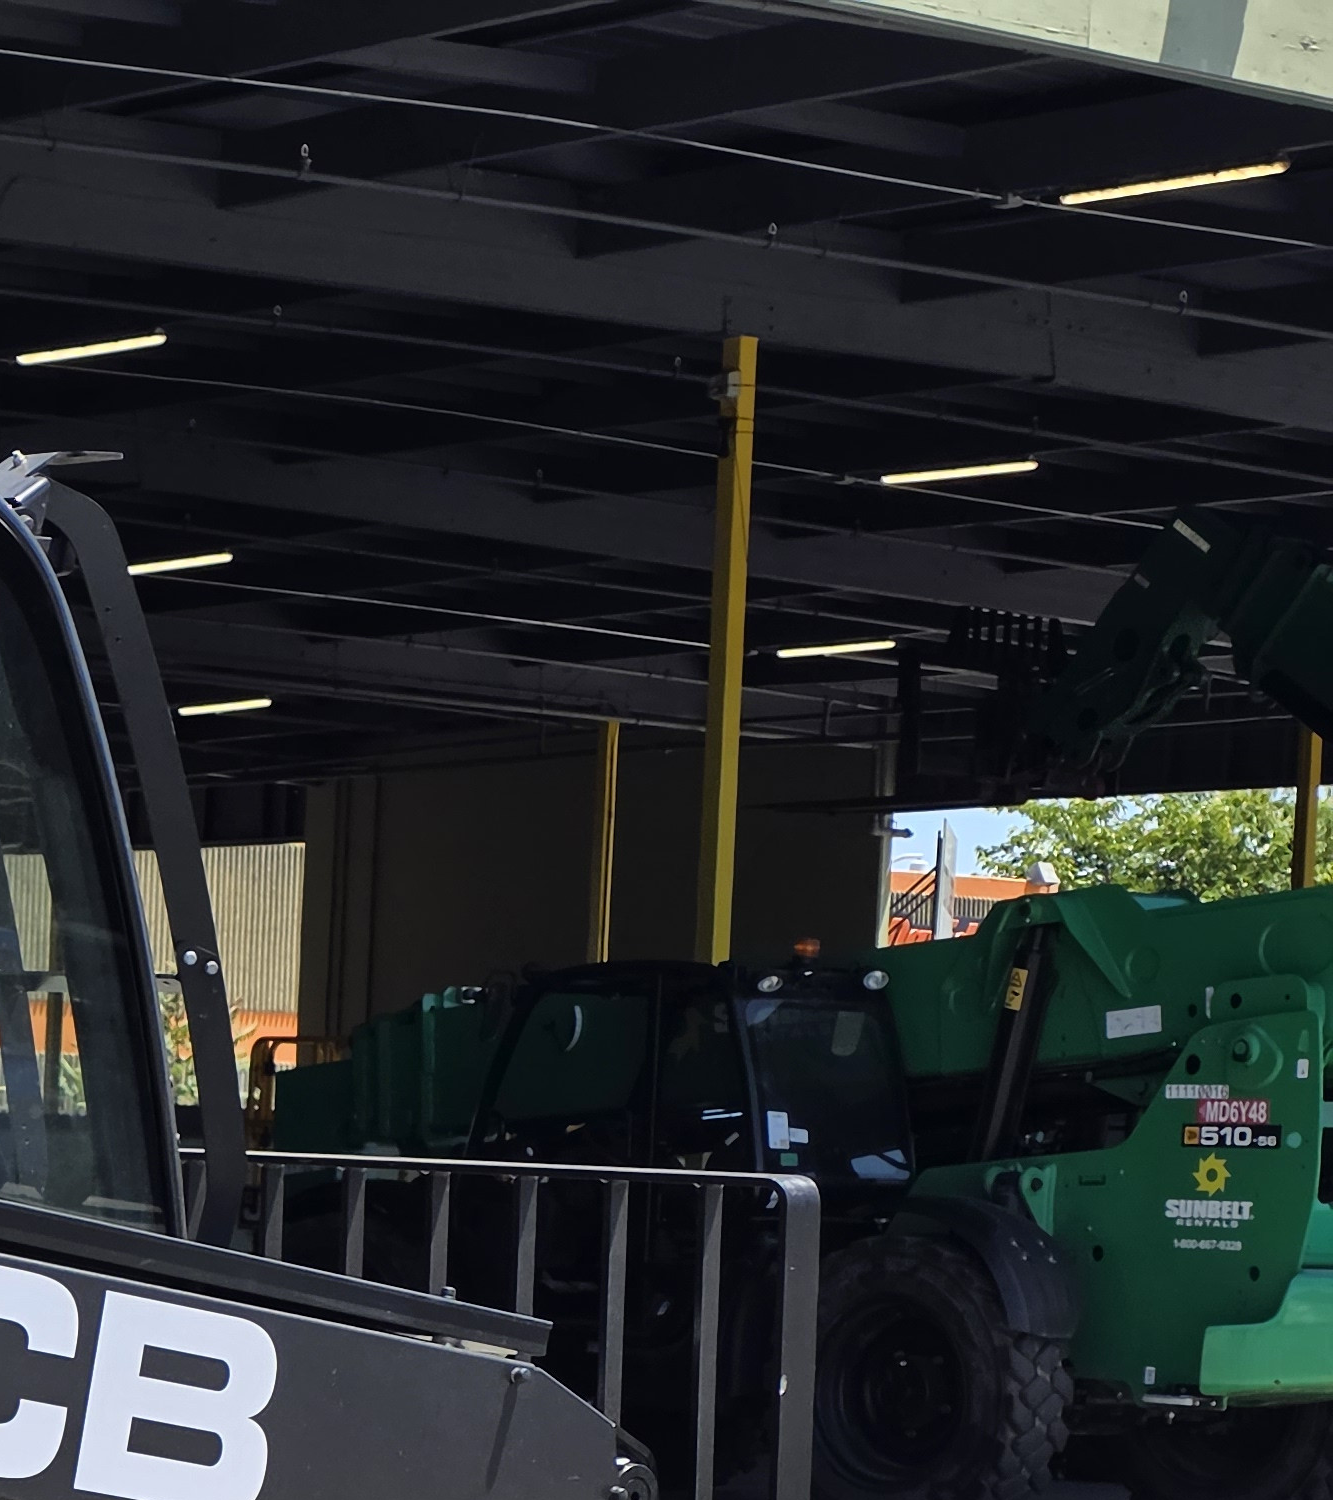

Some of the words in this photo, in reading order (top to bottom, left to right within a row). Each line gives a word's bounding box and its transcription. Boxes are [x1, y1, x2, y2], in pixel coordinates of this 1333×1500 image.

[1205, 1101, 1268, 1123] MD6Y48
[1165, 1199, 1253, 1220] SUNBELT
[1176, 1218, 1239, 1228] RENTALS
